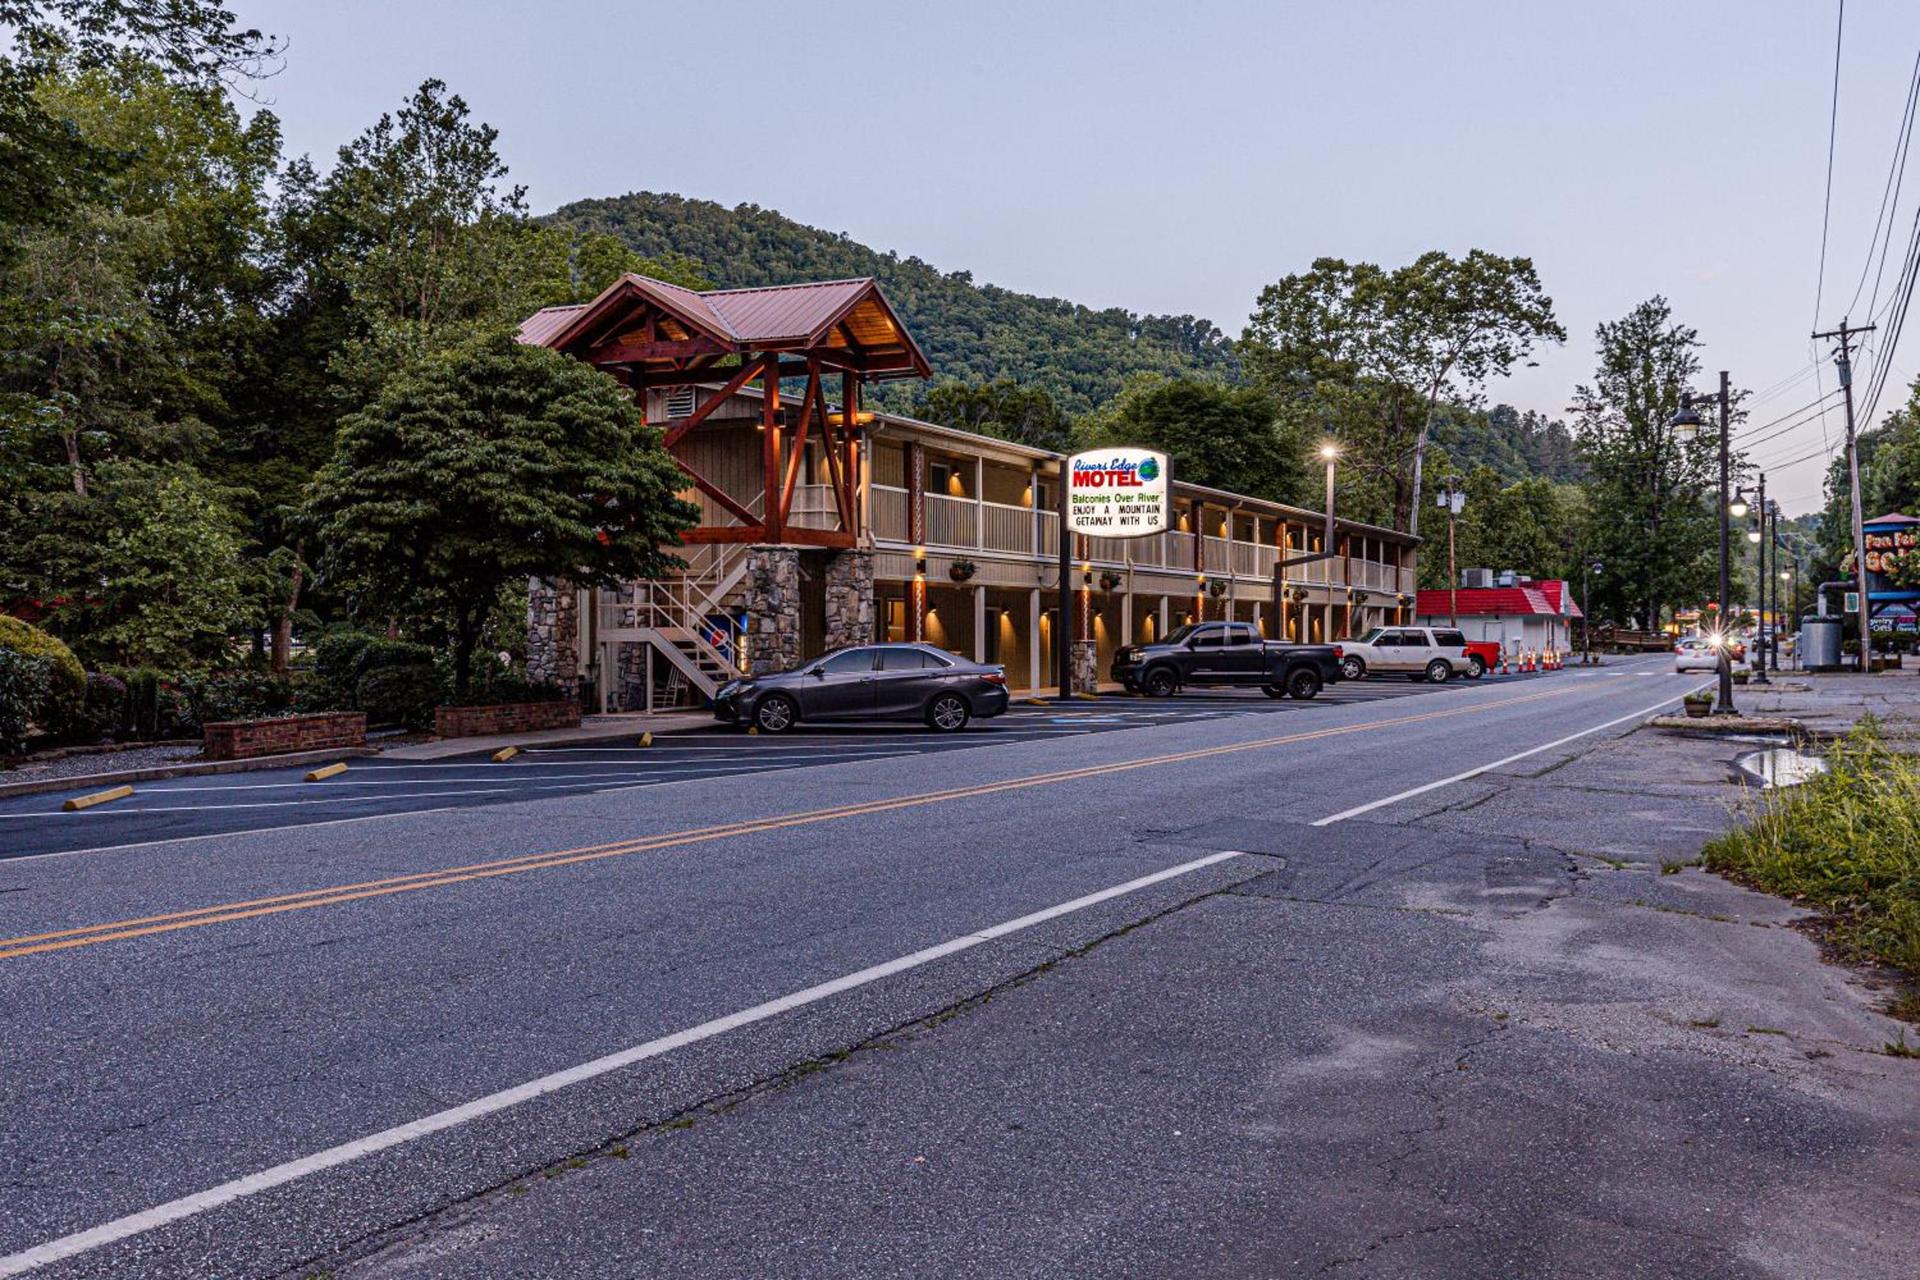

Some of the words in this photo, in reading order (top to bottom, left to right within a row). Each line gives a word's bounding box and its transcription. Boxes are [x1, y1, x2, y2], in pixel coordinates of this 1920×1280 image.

[1073, 458, 1108, 470] Rivers
[1110, 458, 1138, 473] Edge
[1073, 470, 1143, 487] MOTEL
[1072, 494, 1110, 503] Balconies
[1114, 494, 1134, 502] Over
[1138, 493, 1160, 502] River
[1073, 506, 1096, 515] ENJOY
[1104, 505, 1110, 514] A
[1118, 504, 1160, 514] MOUNTAIN
[1076, 516, 1112, 526] GETAWAY
[1120, 516, 1140, 526] WITH
[1148, 516, 1158, 526] US
